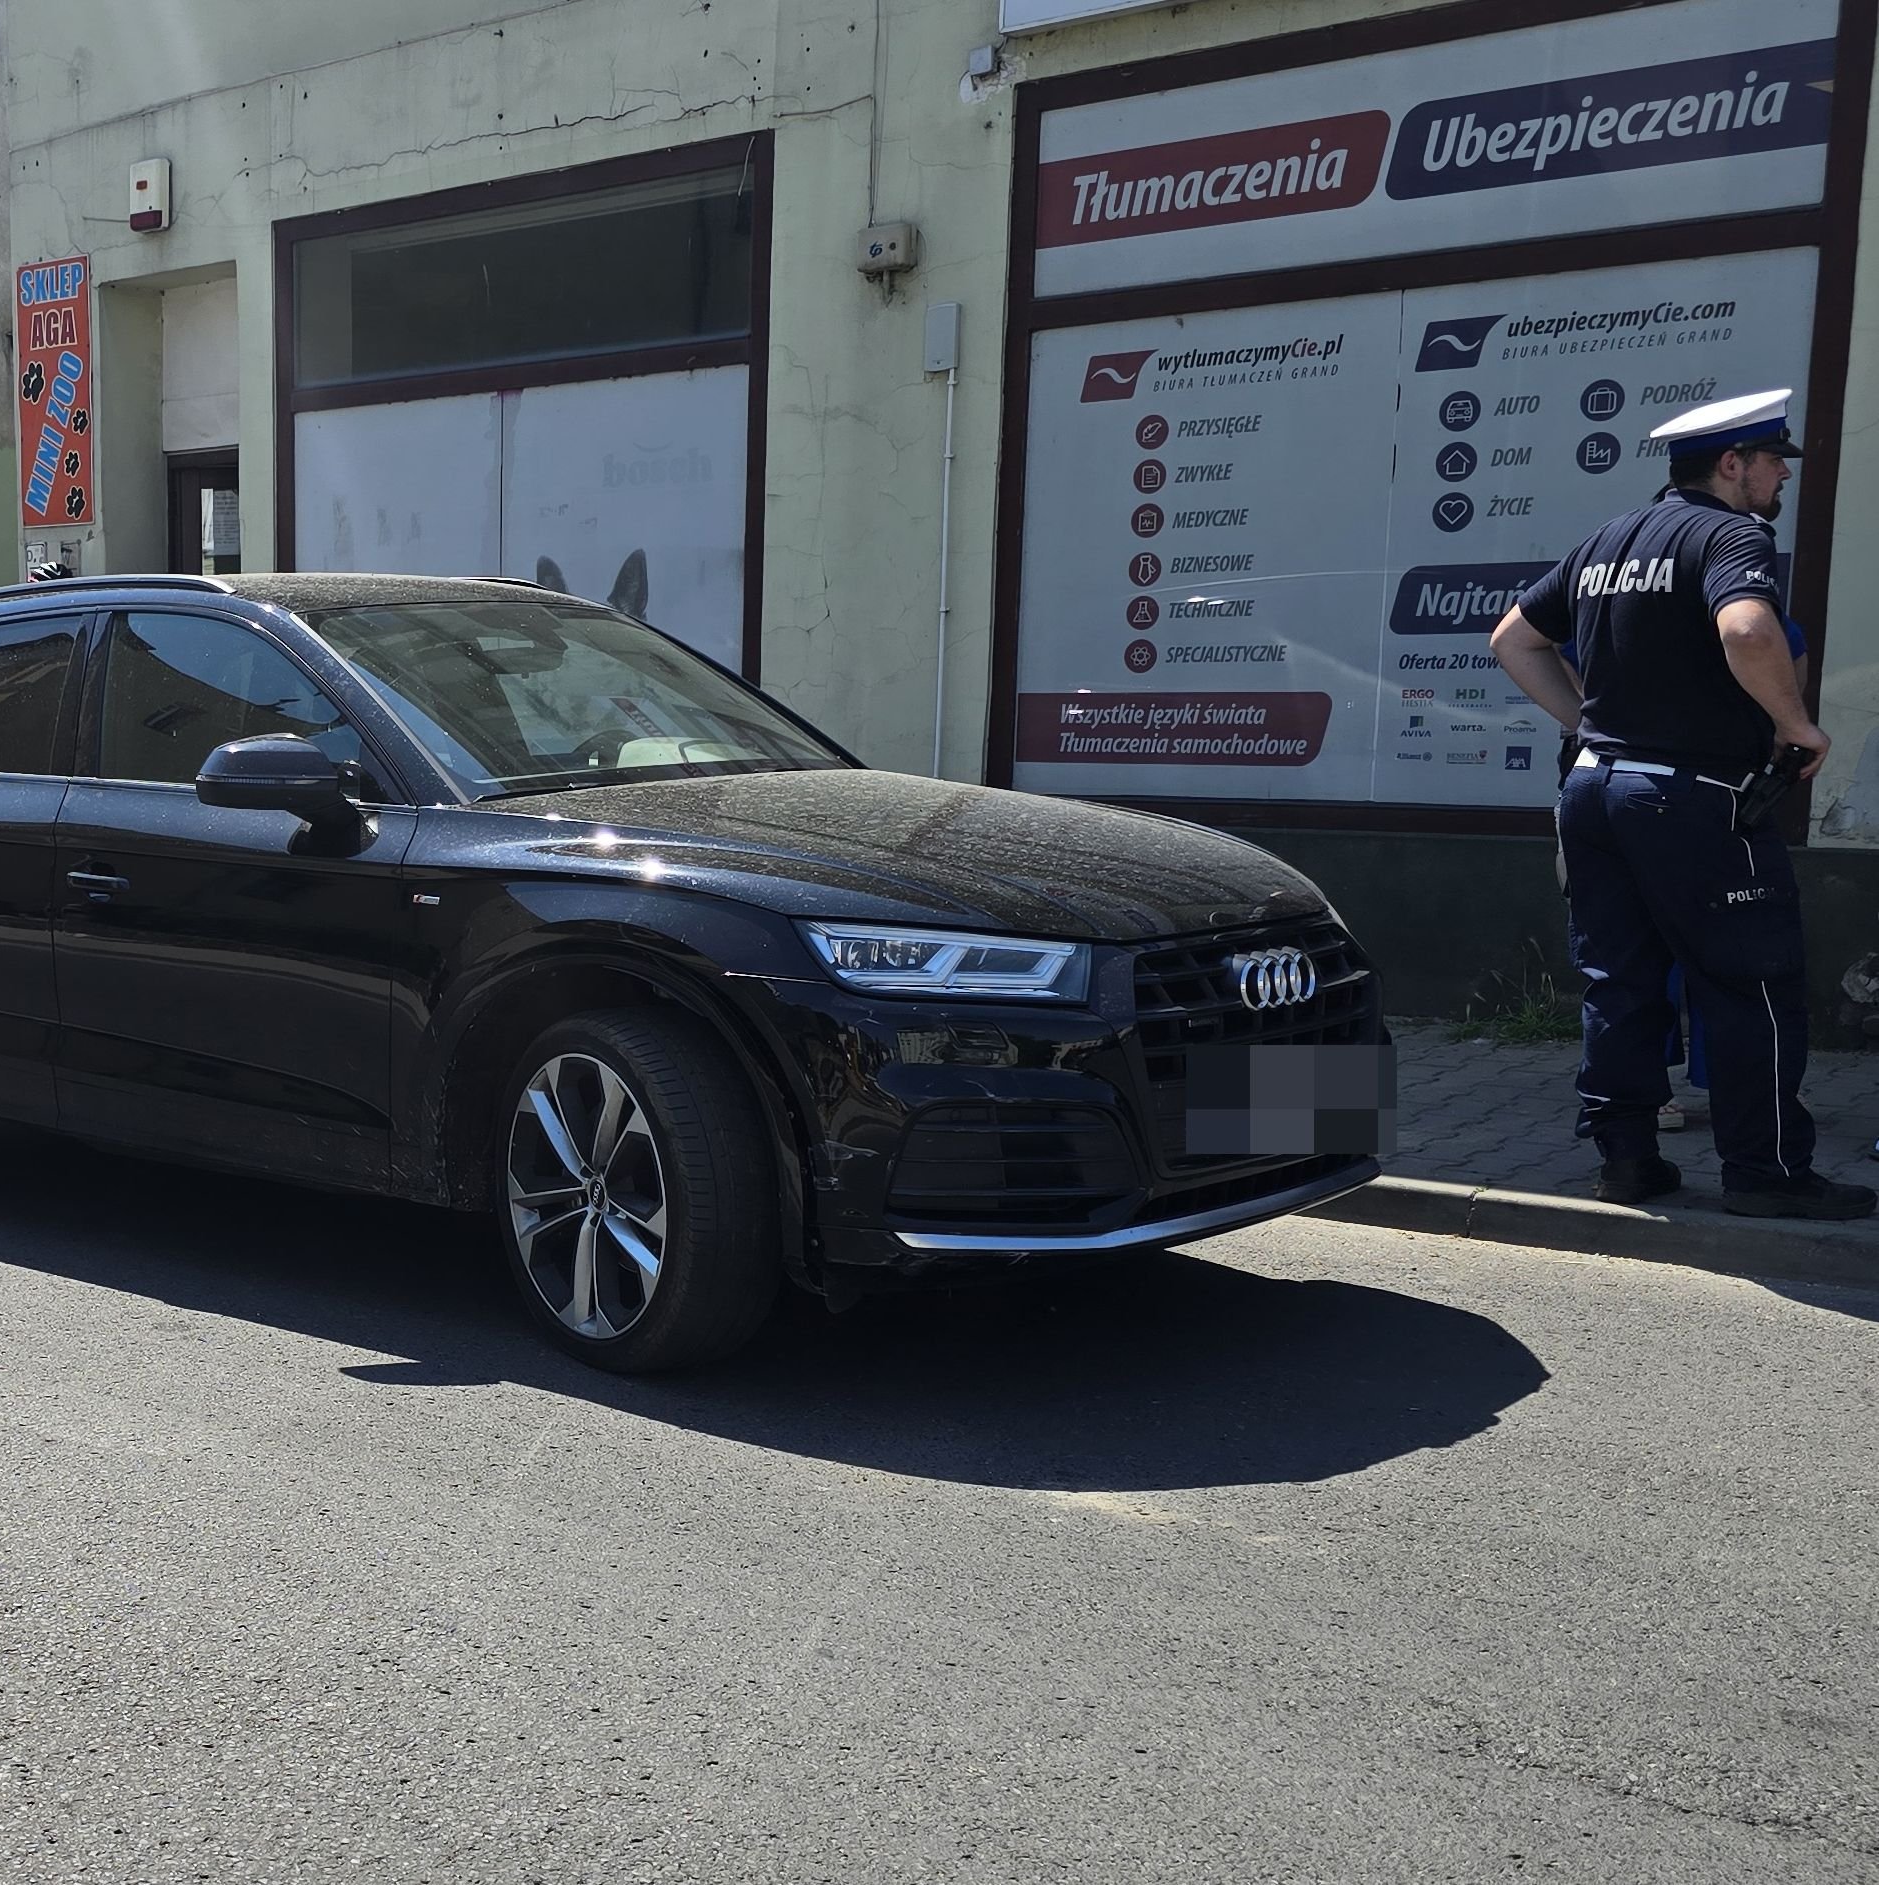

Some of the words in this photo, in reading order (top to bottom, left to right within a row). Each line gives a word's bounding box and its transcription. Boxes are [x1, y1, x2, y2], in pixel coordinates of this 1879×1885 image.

[1073, 138, 1348, 226] Tłumaczenia
[1421, 70, 1790, 172] Ubezpieczenia
[21, 263, 84, 306] SKLEP
[30, 307, 78, 351] AGA
[1507, 300, 1736, 338] ubezpieczymyCie.com
[1158, 334, 1345, 374] wytlumaczymyCie.pl
[1502, 344, 1549, 360] BIURA
[1559, 331, 1668, 355] UBEZPIECZEŃ
[1676, 327, 1733, 345] GRAND
[1153, 376, 1194, 393] BIURA
[1202, 367, 1283, 388] TŁUMACZEŃ
[1291, 364, 1340, 380] GRAND
[1640, 376, 1717, 406] PODRÓŻ
[1494, 395, 1541, 417] AUTO
[25, 423, 64, 517] MINI
[46, 351, 84, 429] ZOO
[1177, 414, 1263, 438] PRZYSIĘGŁE
[1491, 447, 1533, 467] DOM
[1636, 439, 1670, 458] FIR
[1174, 463, 1234, 484] ZWYKŁE
[1487, 494, 1534, 517] ŻYCIE
[1172, 508, 1249, 530] MEDYCZNE
[1170, 553, 1255, 574] BIZNESOWE
[1577, 557, 1675, 600] POLICJA
[1168, 600, 1256, 619] TECHNICZNE
[1165, 644, 1288, 664] SPECJALISTYCZNE
[1399, 653, 1446, 670] Oferta
[1448, 653, 1469, 670] 20
[1471, 654, 1504, 670] tow
[1401, 689, 1435, 699] ERGO
[1455, 688, 1486, 700] HDI
[1060, 703, 1144, 729] Wszystkie
[1144, 703, 1199, 729] języki
[1202, 703, 1267, 725] świata
[1059, 732, 1169, 754] Tłumaczenia
[1171, 733, 1308, 756] samochodowe
[1400, 730, 1432, 738] AVIVA
